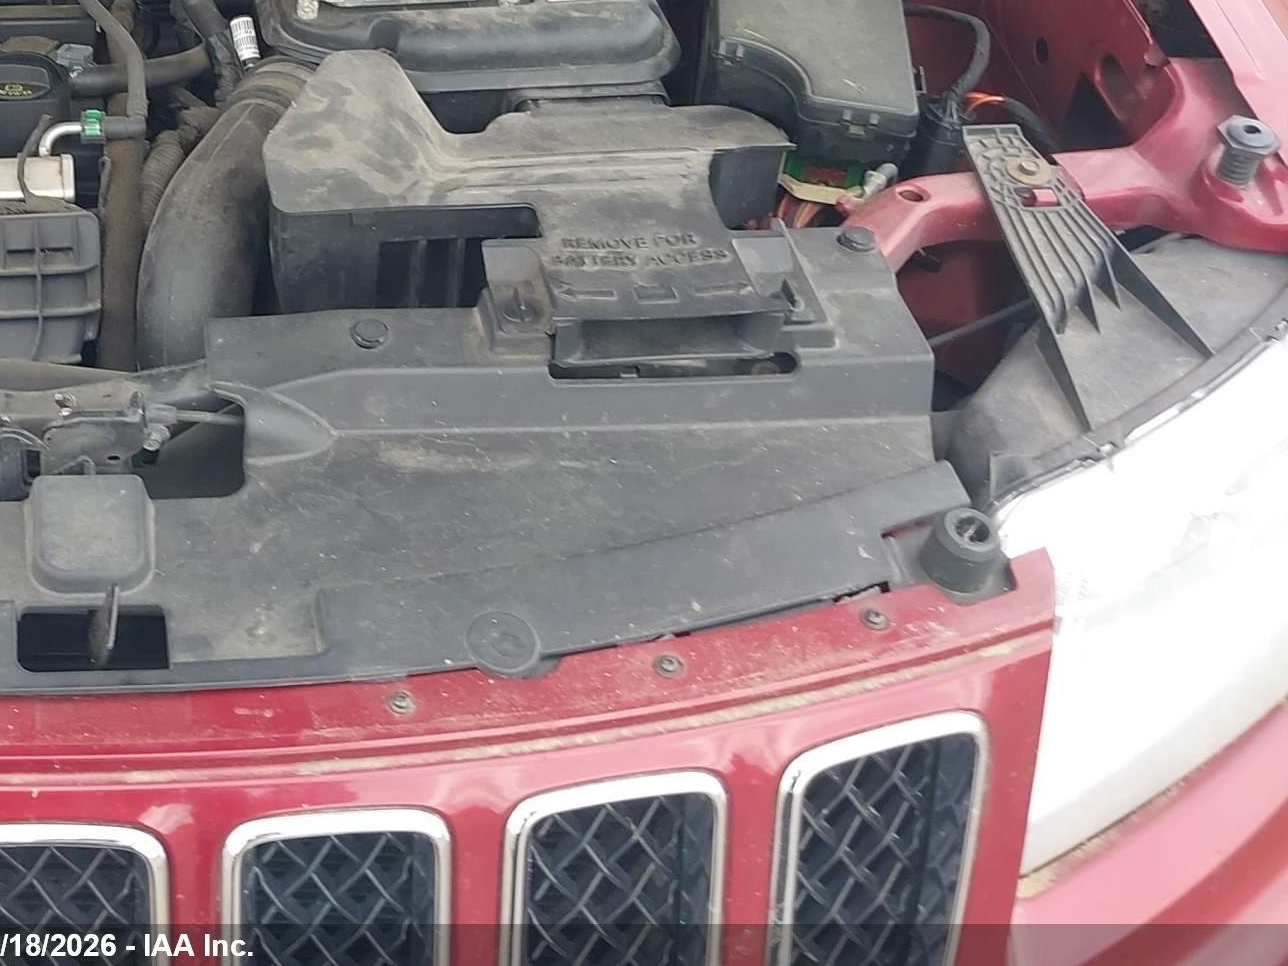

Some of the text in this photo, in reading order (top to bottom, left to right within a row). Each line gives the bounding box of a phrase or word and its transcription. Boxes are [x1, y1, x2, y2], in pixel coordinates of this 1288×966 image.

[562, 233, 697, 250] REMOVE FOR
[648, 249, 730, 266] ACCESS
